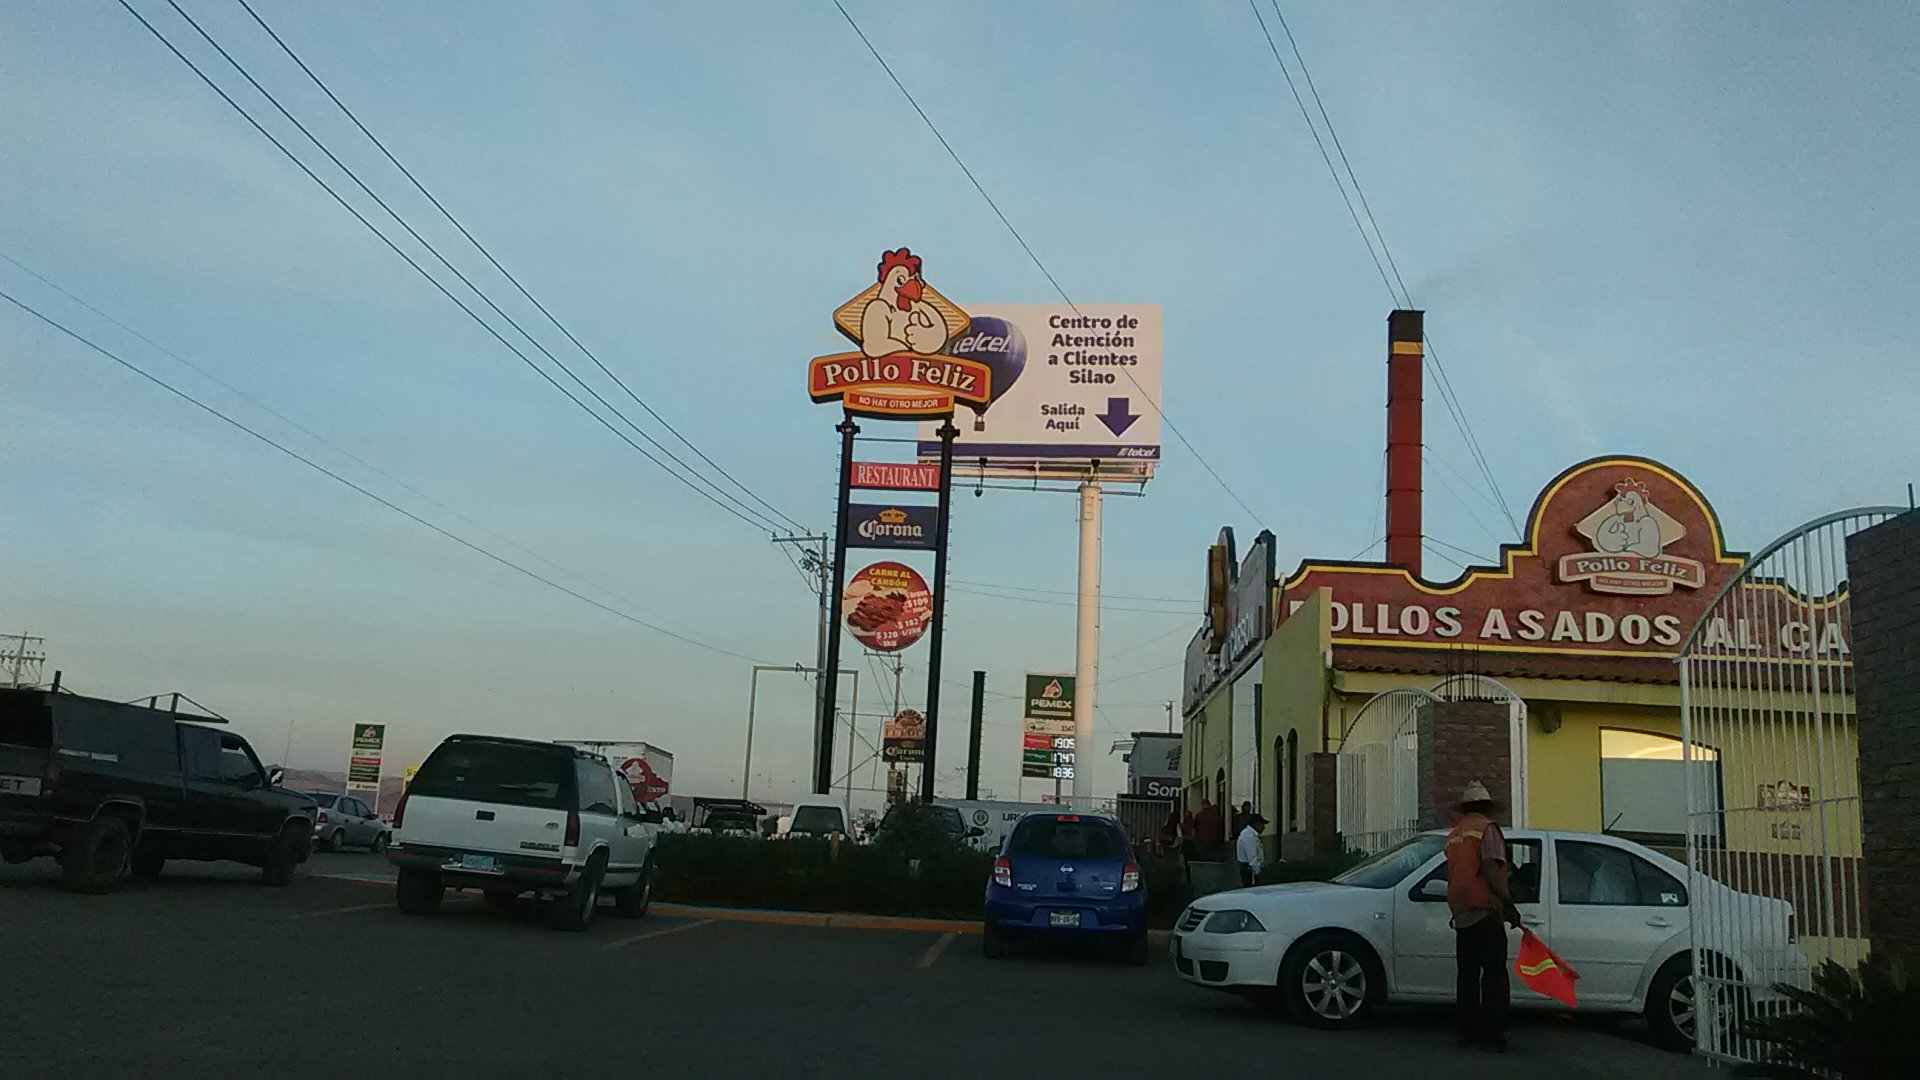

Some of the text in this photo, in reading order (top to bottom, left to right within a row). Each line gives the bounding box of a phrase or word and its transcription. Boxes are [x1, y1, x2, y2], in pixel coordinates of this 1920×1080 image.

[1049, 314, 1139, 330] Centro de
[1051, 331, 1134, 348] Atención
[1048, 351, 1138, 366] a Clientes
[823, 358, 976, 392] Pollo Feliz
[1069, 369, 1115, 384] Silao
[859, 396, 938, 408] NO HAY OTRO MEJOR
[1041, 403, 1085, 416] Salida
[1045, 417, 1079, 433] Aquí
[1127, 447, 1156, 457] telcel
[857, 465, 935, 487] RESTAURANT
[858, 519, 922, 541] Corona
[869, 568, 912, 579] CARNE AL
[1576, 558, 1689, 578] Pollo Feliz
[1480, 608, 1681, 645] ASADOS
[1702, 617, 1760, 649] AL
[1031, 699, 1072, 709] PEMEX
